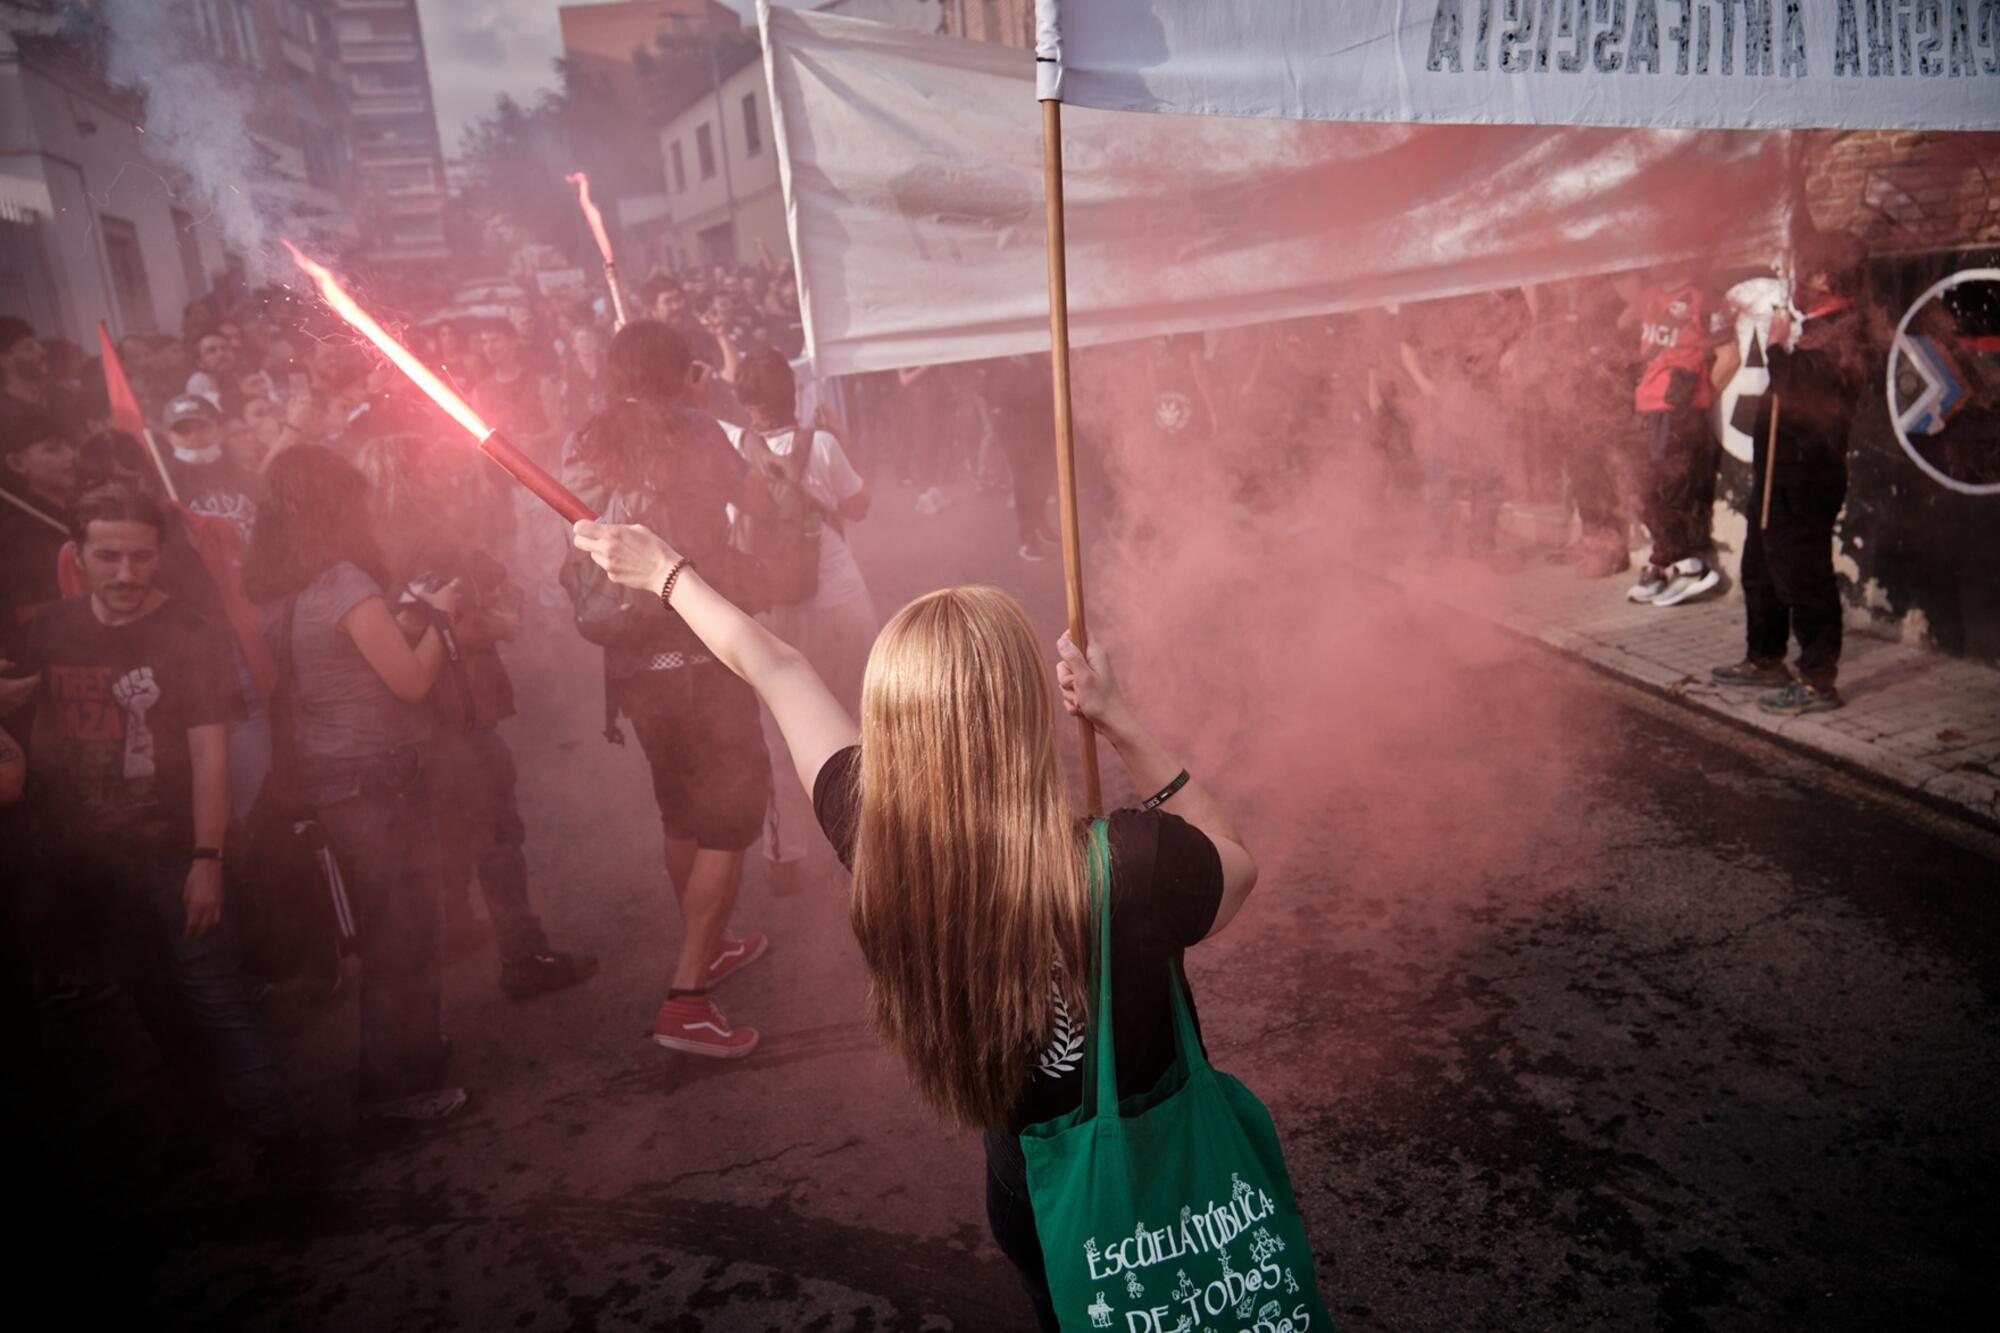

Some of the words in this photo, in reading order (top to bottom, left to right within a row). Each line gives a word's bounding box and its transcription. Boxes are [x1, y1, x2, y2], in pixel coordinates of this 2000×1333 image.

[1086, 1215, 1199, 1280] ESCUELA
[1125, 1304, 1178, 1333] DE
[1182, 1253, 1281, 1326] TOD@S
